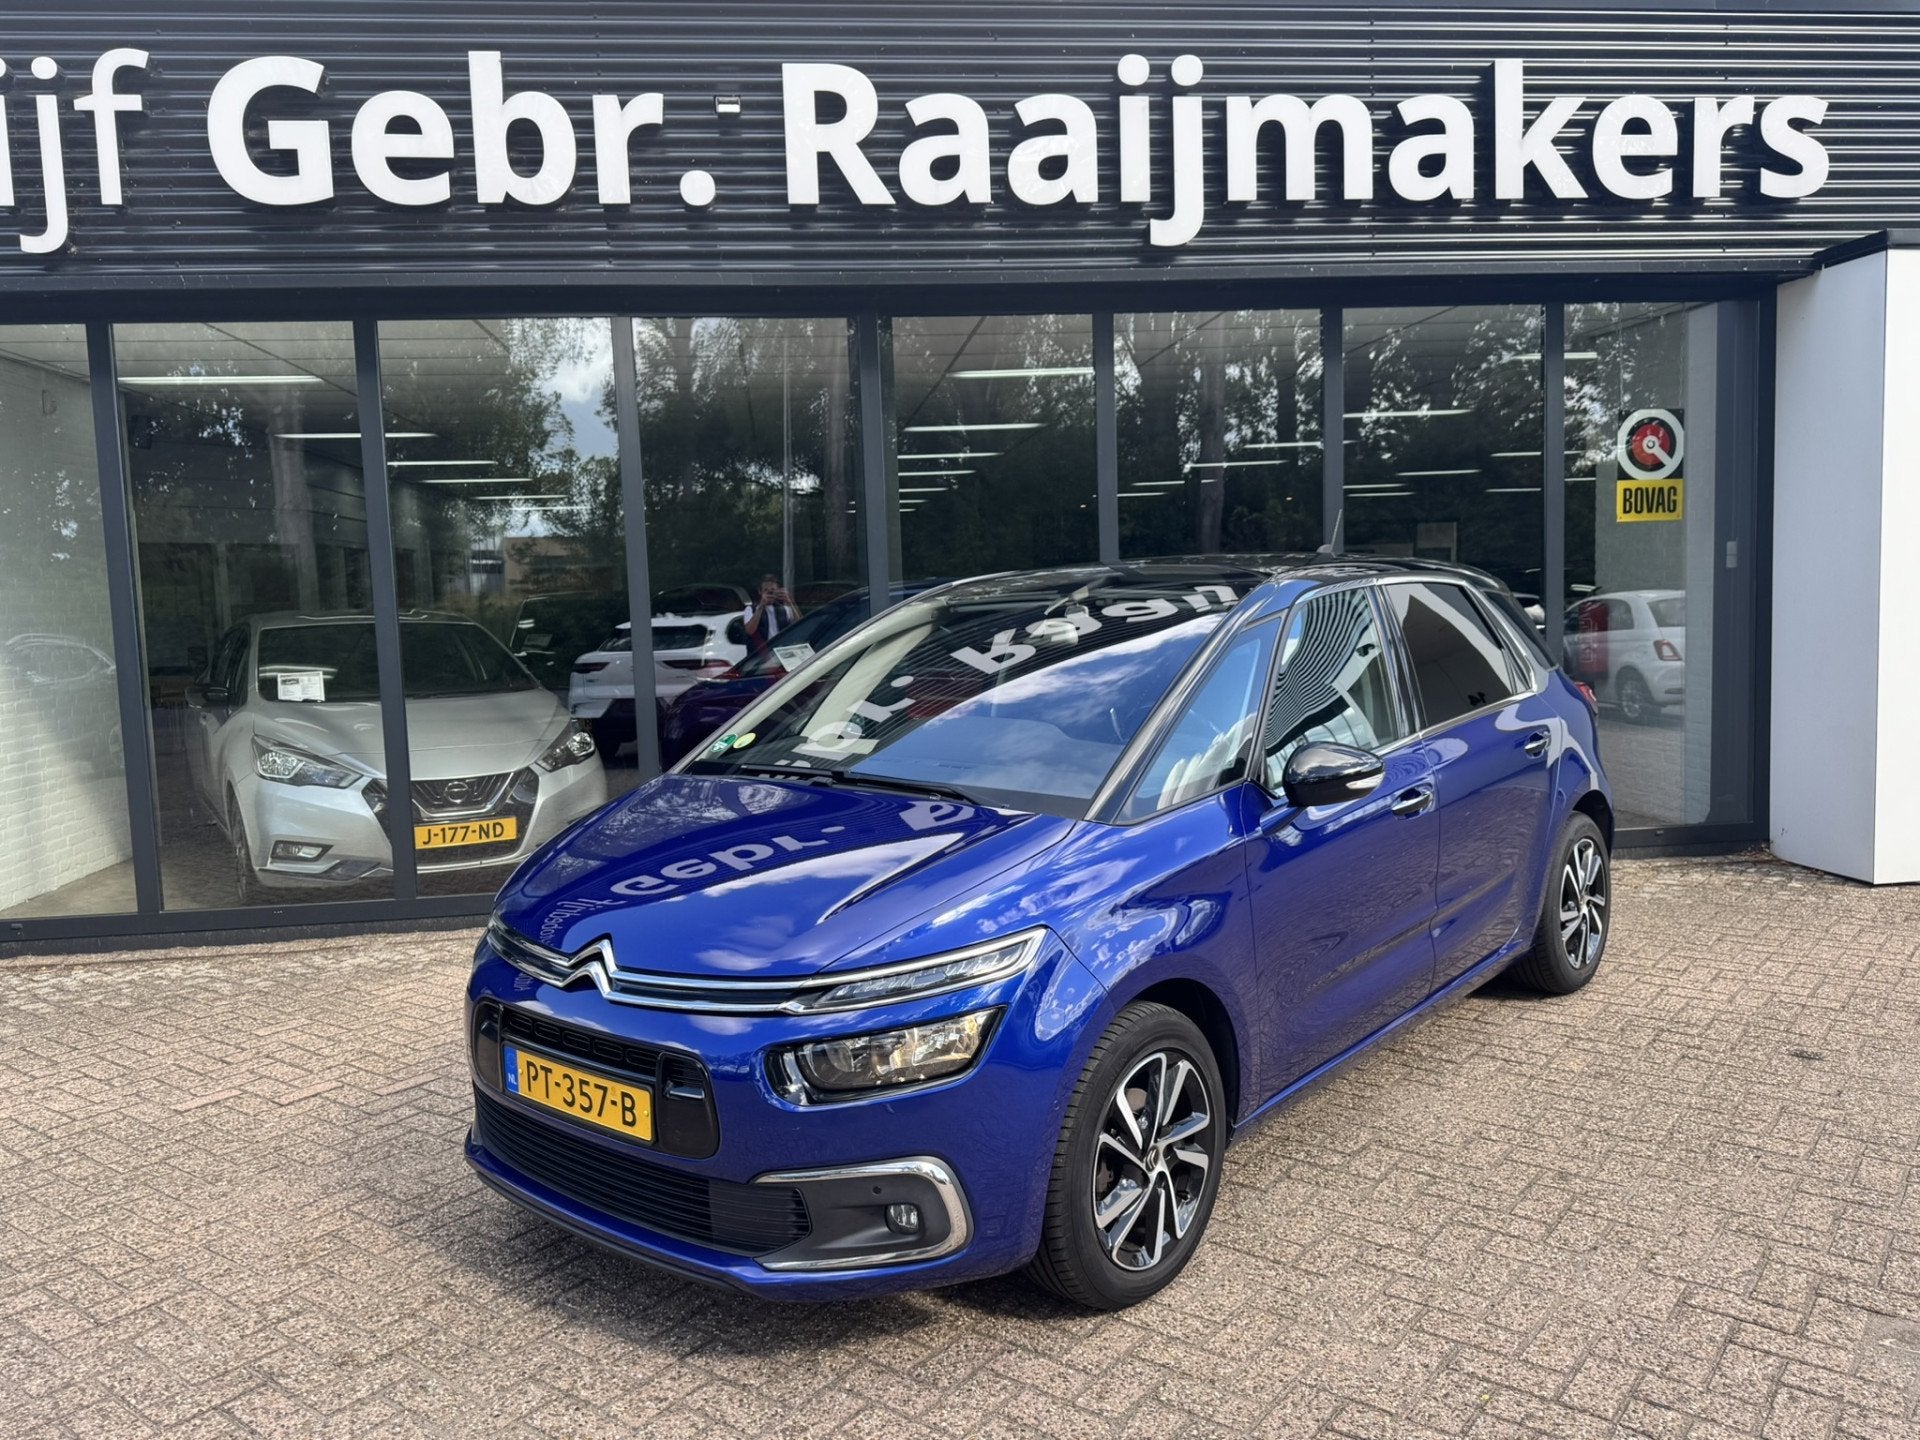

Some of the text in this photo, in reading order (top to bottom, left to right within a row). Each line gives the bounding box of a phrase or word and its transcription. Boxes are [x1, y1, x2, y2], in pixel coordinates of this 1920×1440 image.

[207, 51, 716, 206] Gebr.
[781, 54, 1830, 248] Raaijmakers
[1622, 486, 1678, 514] BOVAG
[422, 822, 505, 845] J-177-ND
[526, 1060, 637, 1127] PT-357-B
